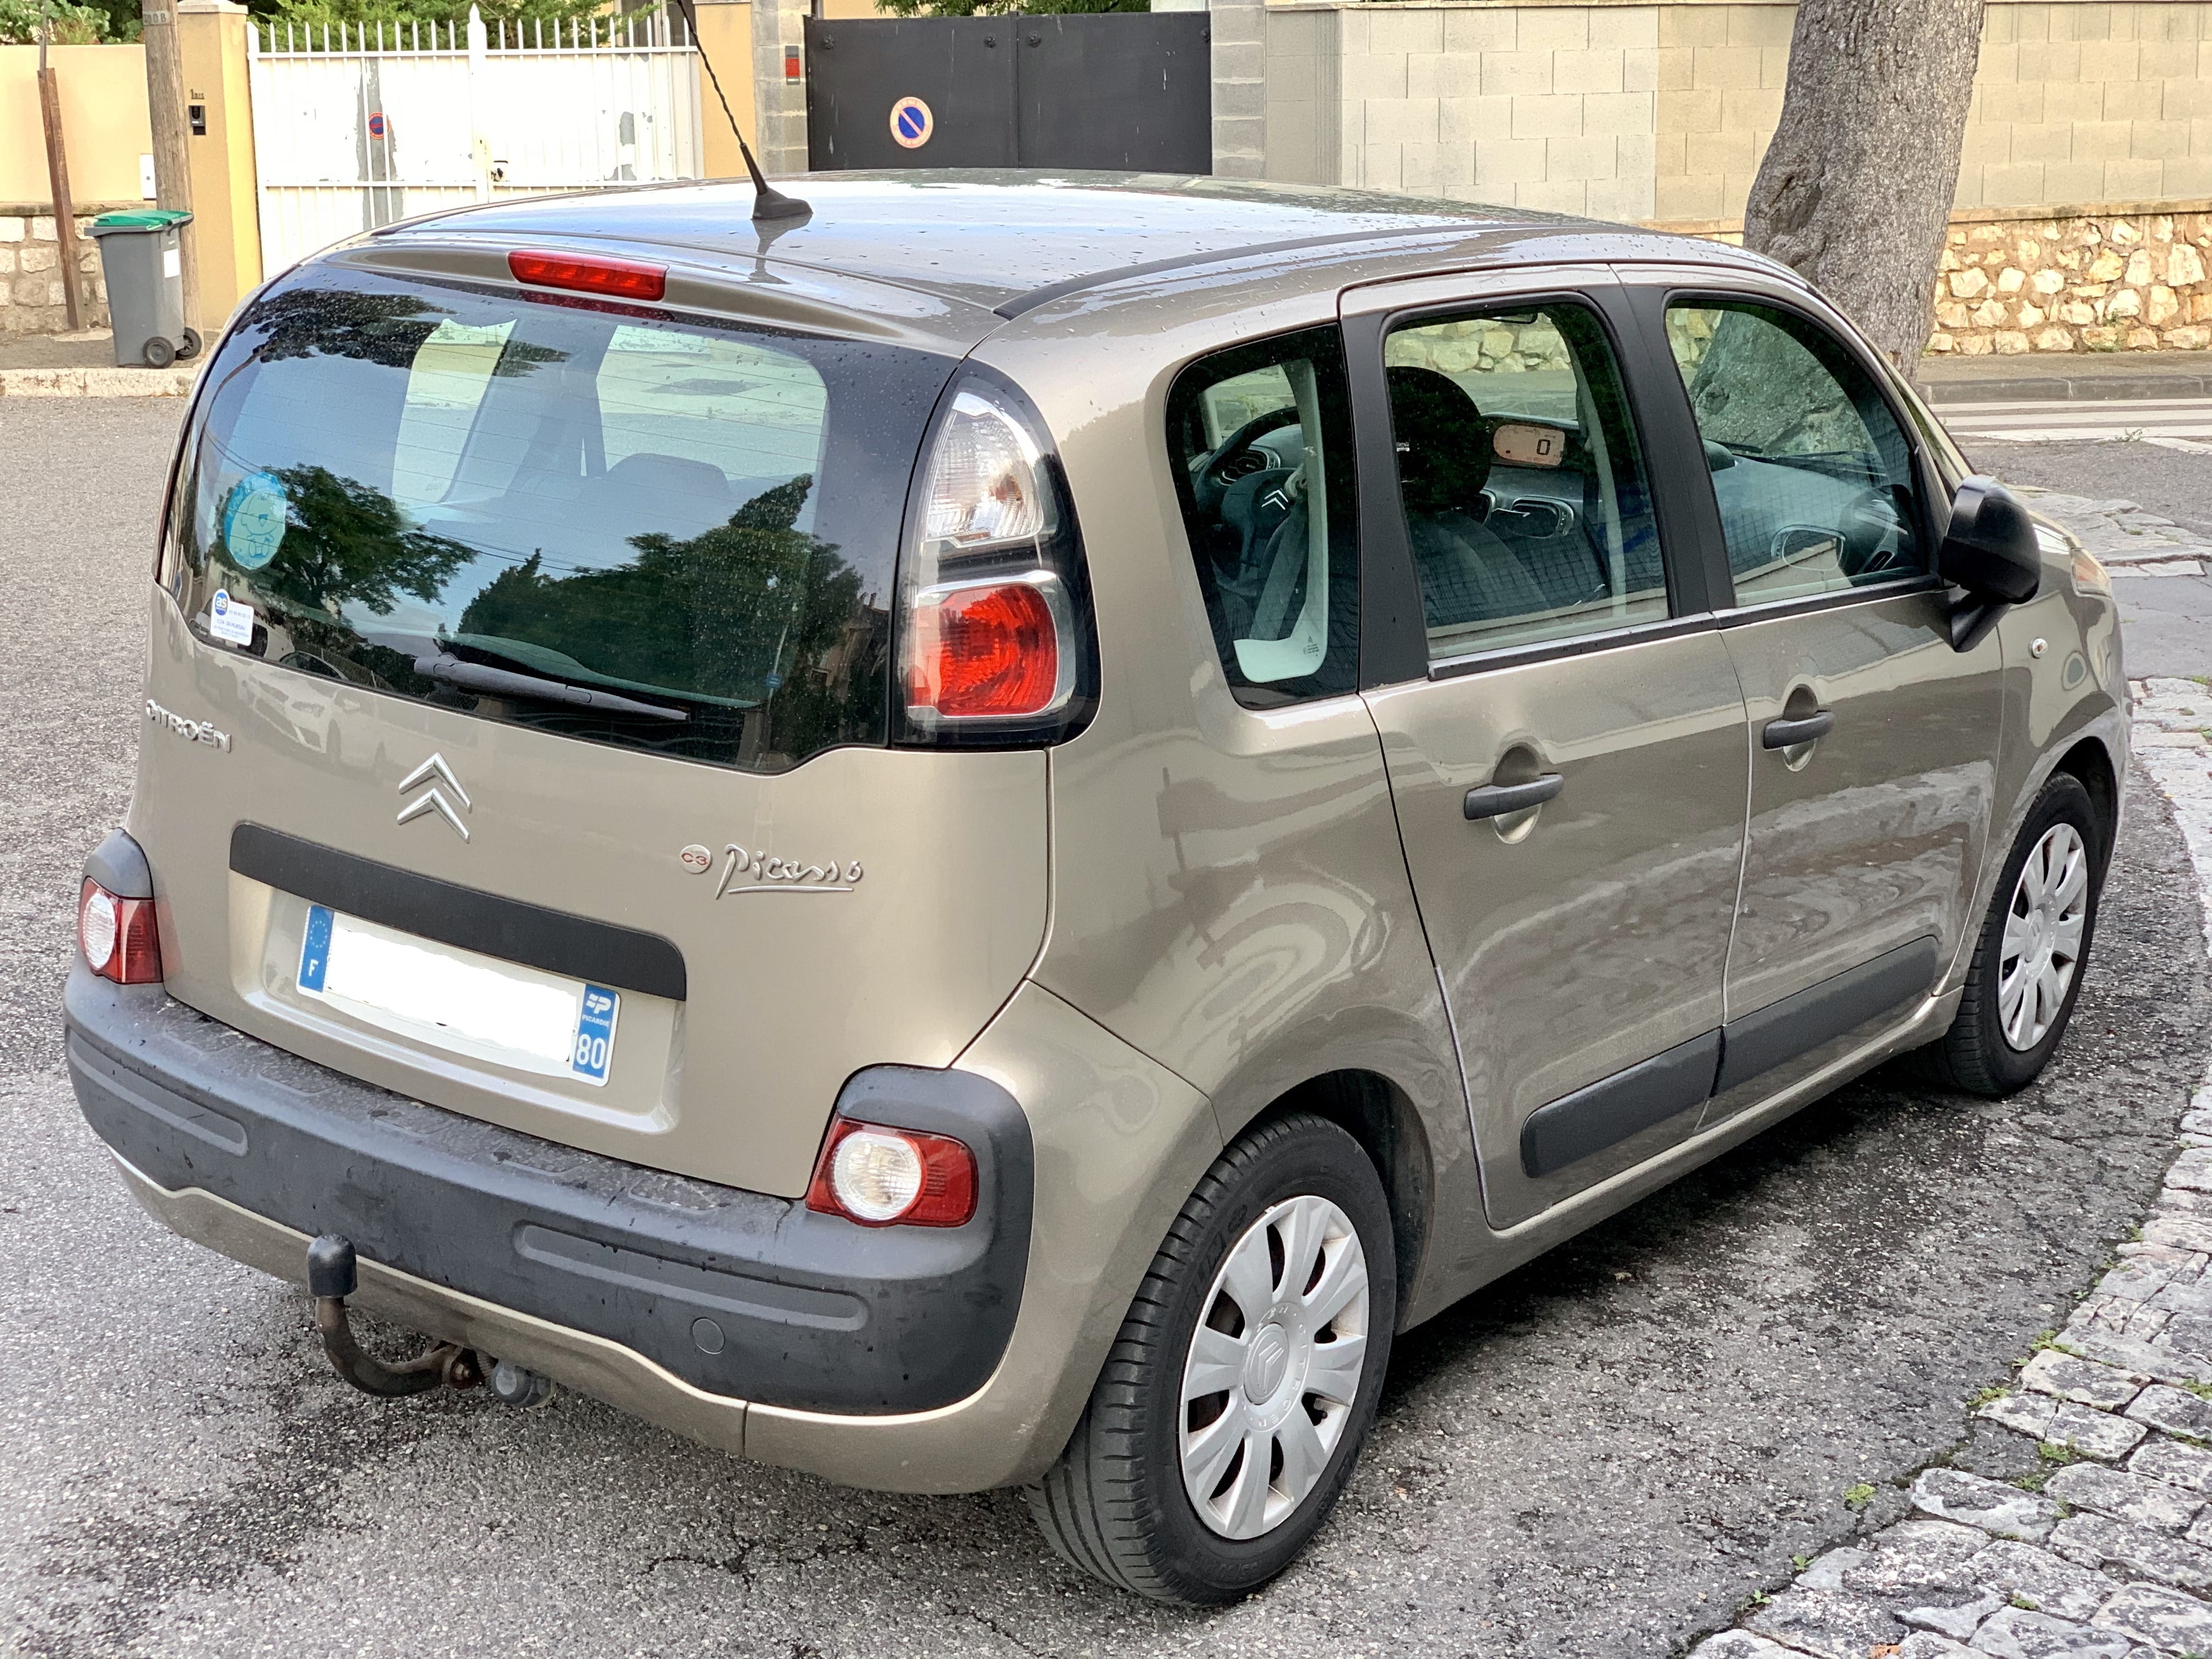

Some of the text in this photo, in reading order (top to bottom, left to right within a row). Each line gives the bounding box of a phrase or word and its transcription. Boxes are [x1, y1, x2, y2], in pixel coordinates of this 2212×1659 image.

[1536, 439, 1551, 455] 0
[146, 699, 232, 754] CITROËN
[680, 843, 864, 900] C3 Picasso
[308, 958, 319, 977] F
[582, 1014, 610, 1027] PICARDIE
[576, 1034, 606, 1069] 80
